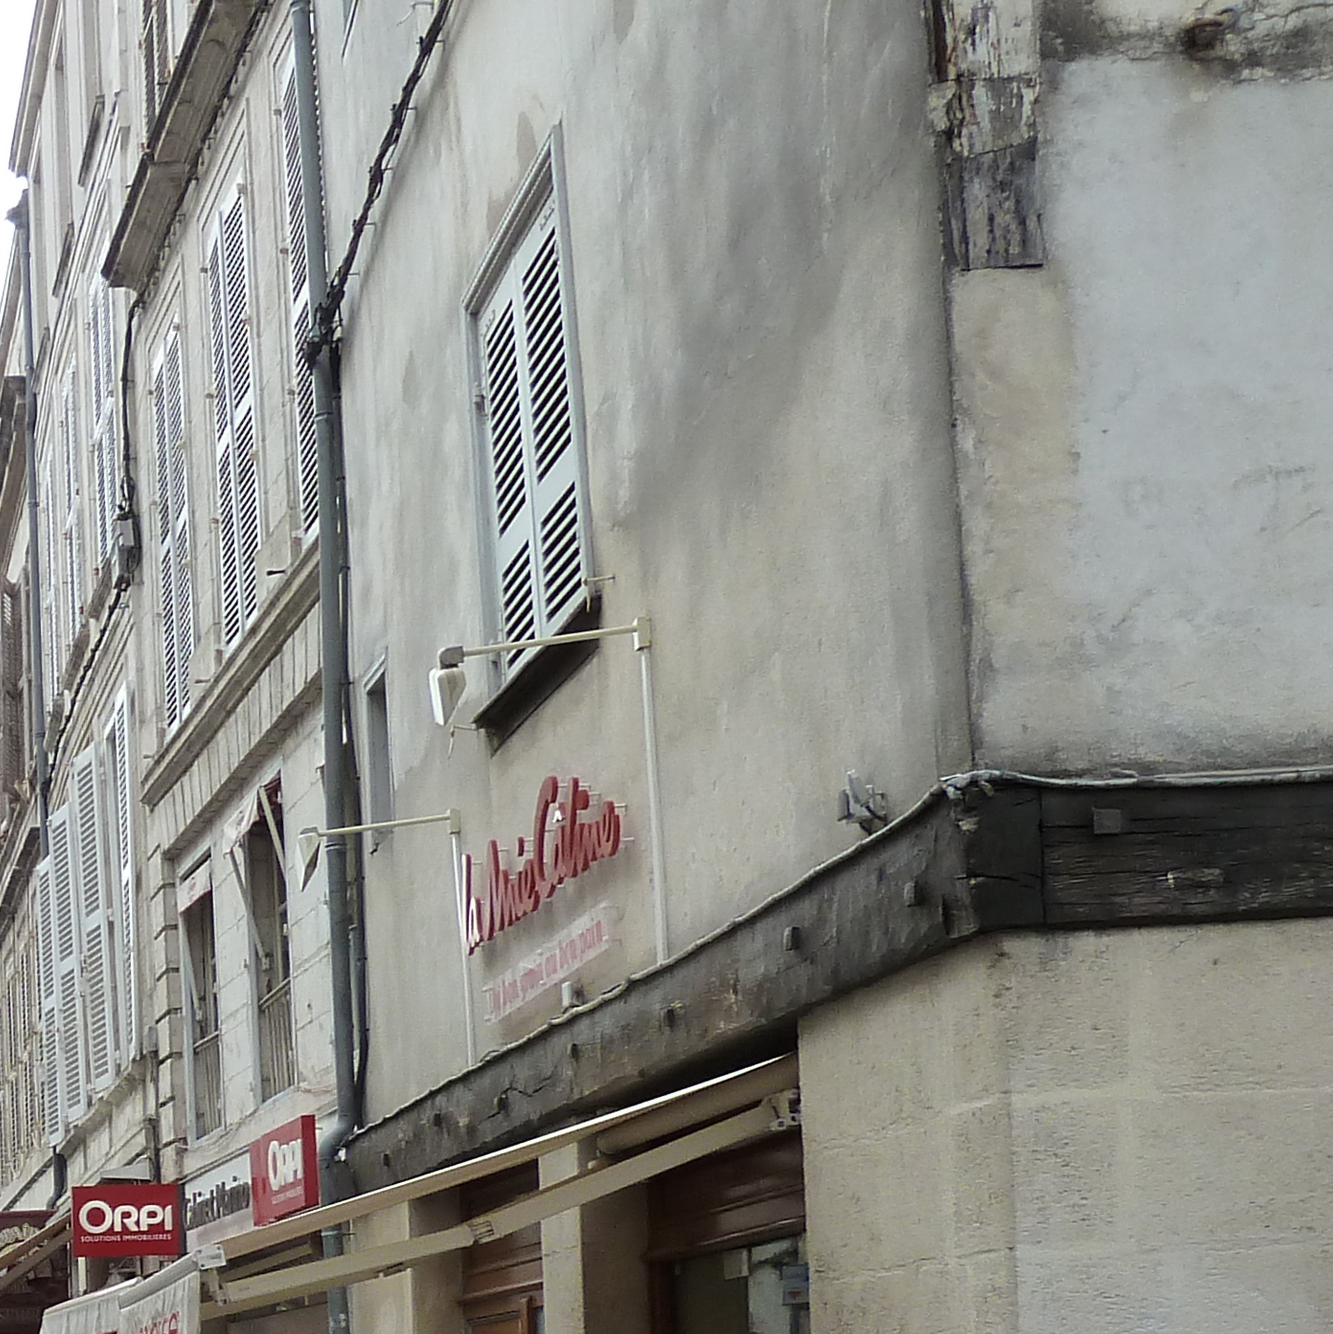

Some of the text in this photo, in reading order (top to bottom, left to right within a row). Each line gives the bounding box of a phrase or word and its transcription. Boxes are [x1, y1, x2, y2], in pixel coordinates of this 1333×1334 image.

[267, 1138, 302, 1191] ORPI
[78, 1199, 173, 1234] ORPI
[80, 1235, 121, 1243] SOLUTIONS
